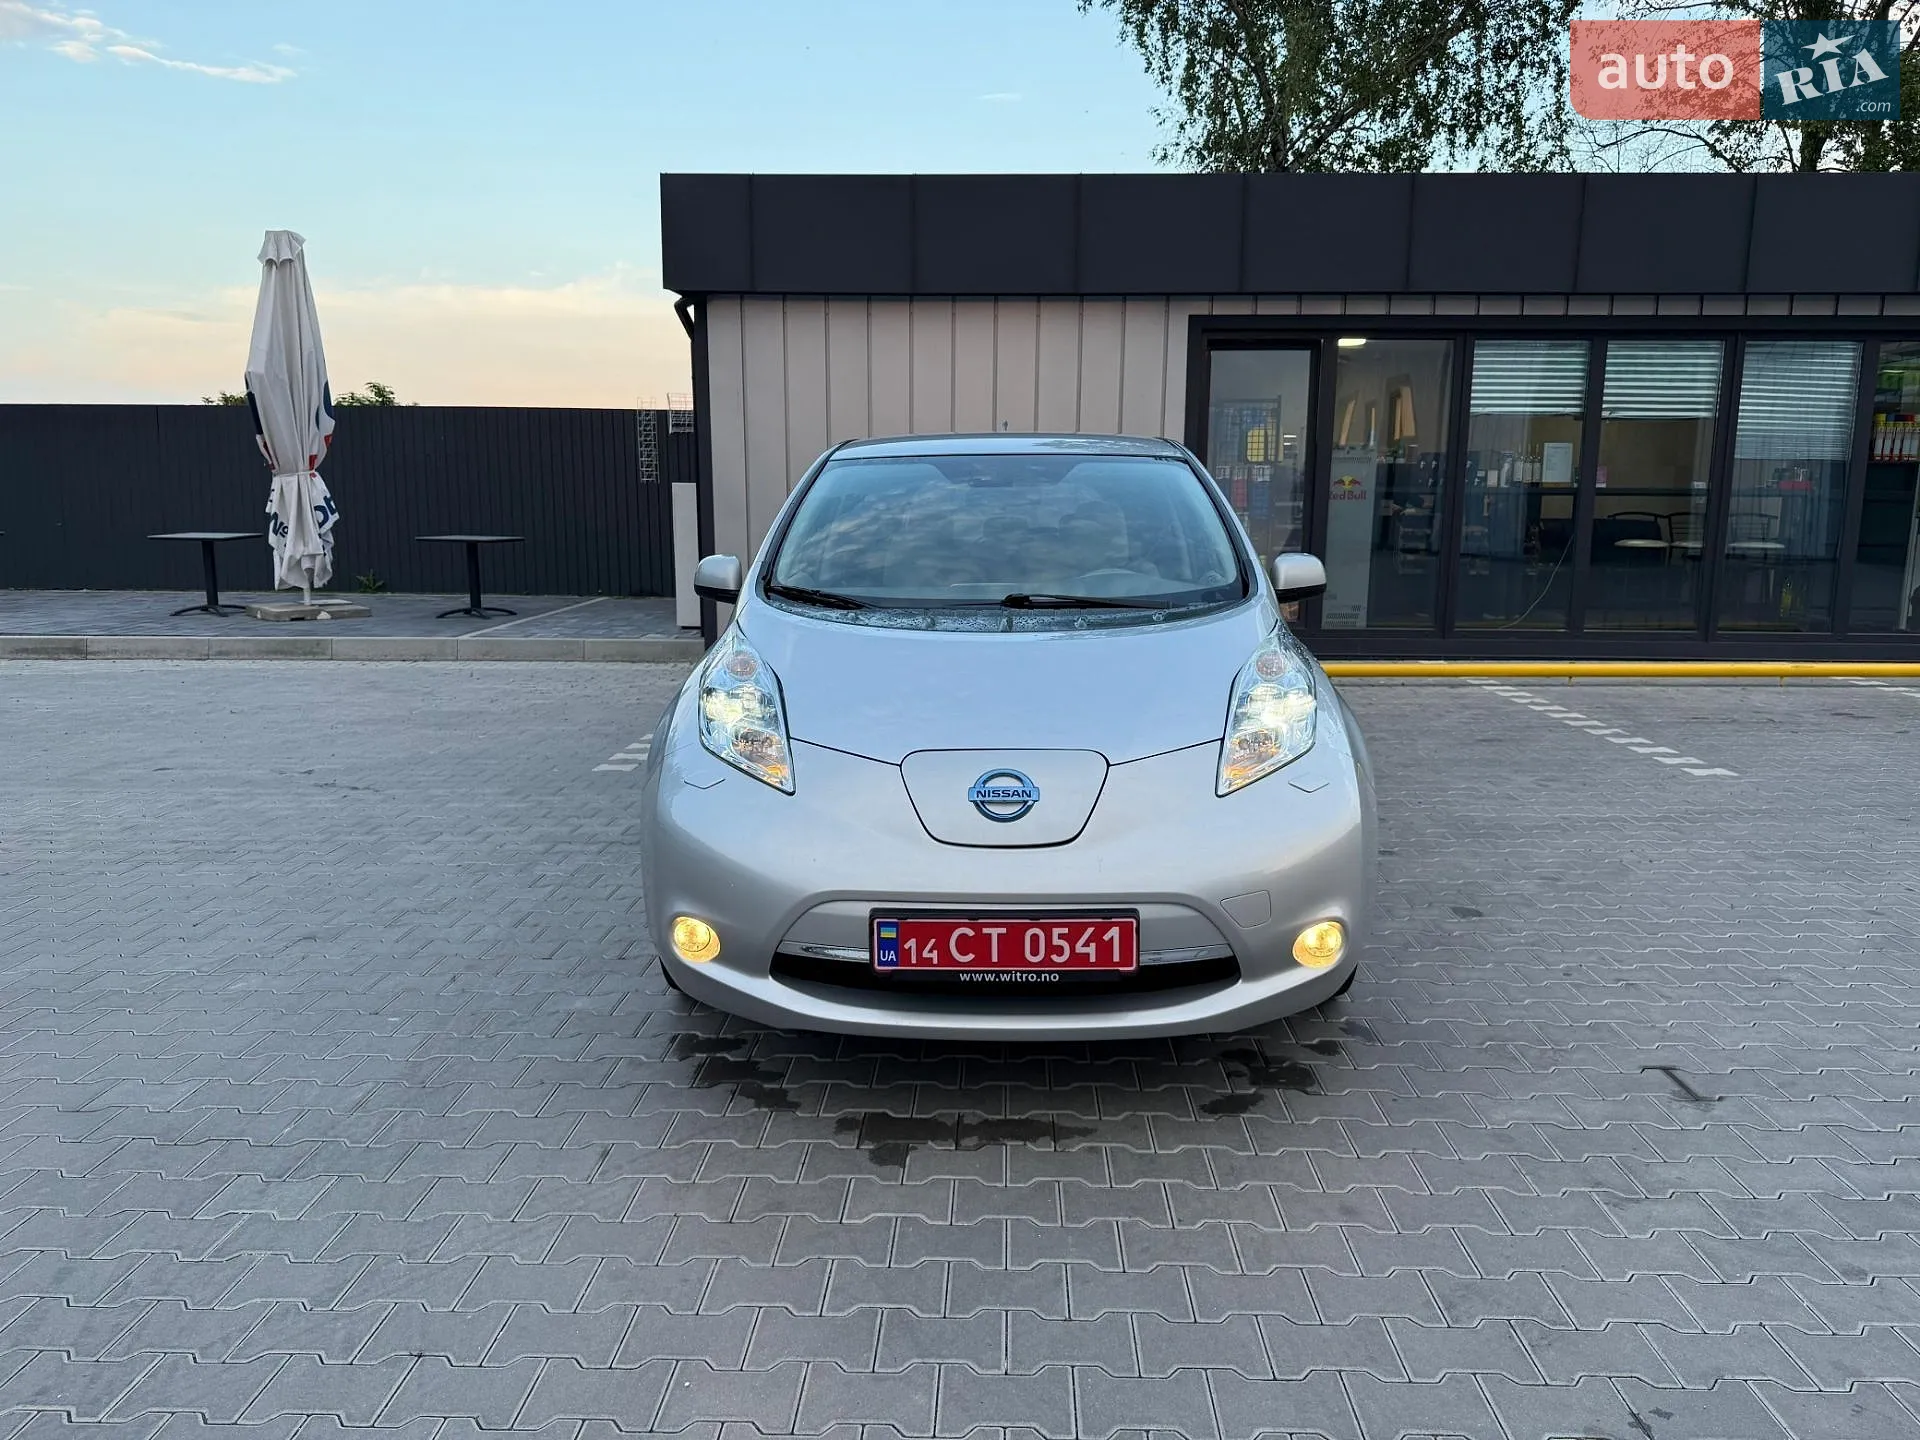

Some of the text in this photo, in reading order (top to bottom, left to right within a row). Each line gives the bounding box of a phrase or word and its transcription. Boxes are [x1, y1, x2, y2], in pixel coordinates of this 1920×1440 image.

[1347, 490, 1367, 501] Bull
[976, 789, 1032, 799] NISSAN
[903, 926, 1121, 965] 14 CT 0541
[880, 949, 897, 962] UA
[960, 970, 1060, 982] www.witro.no
